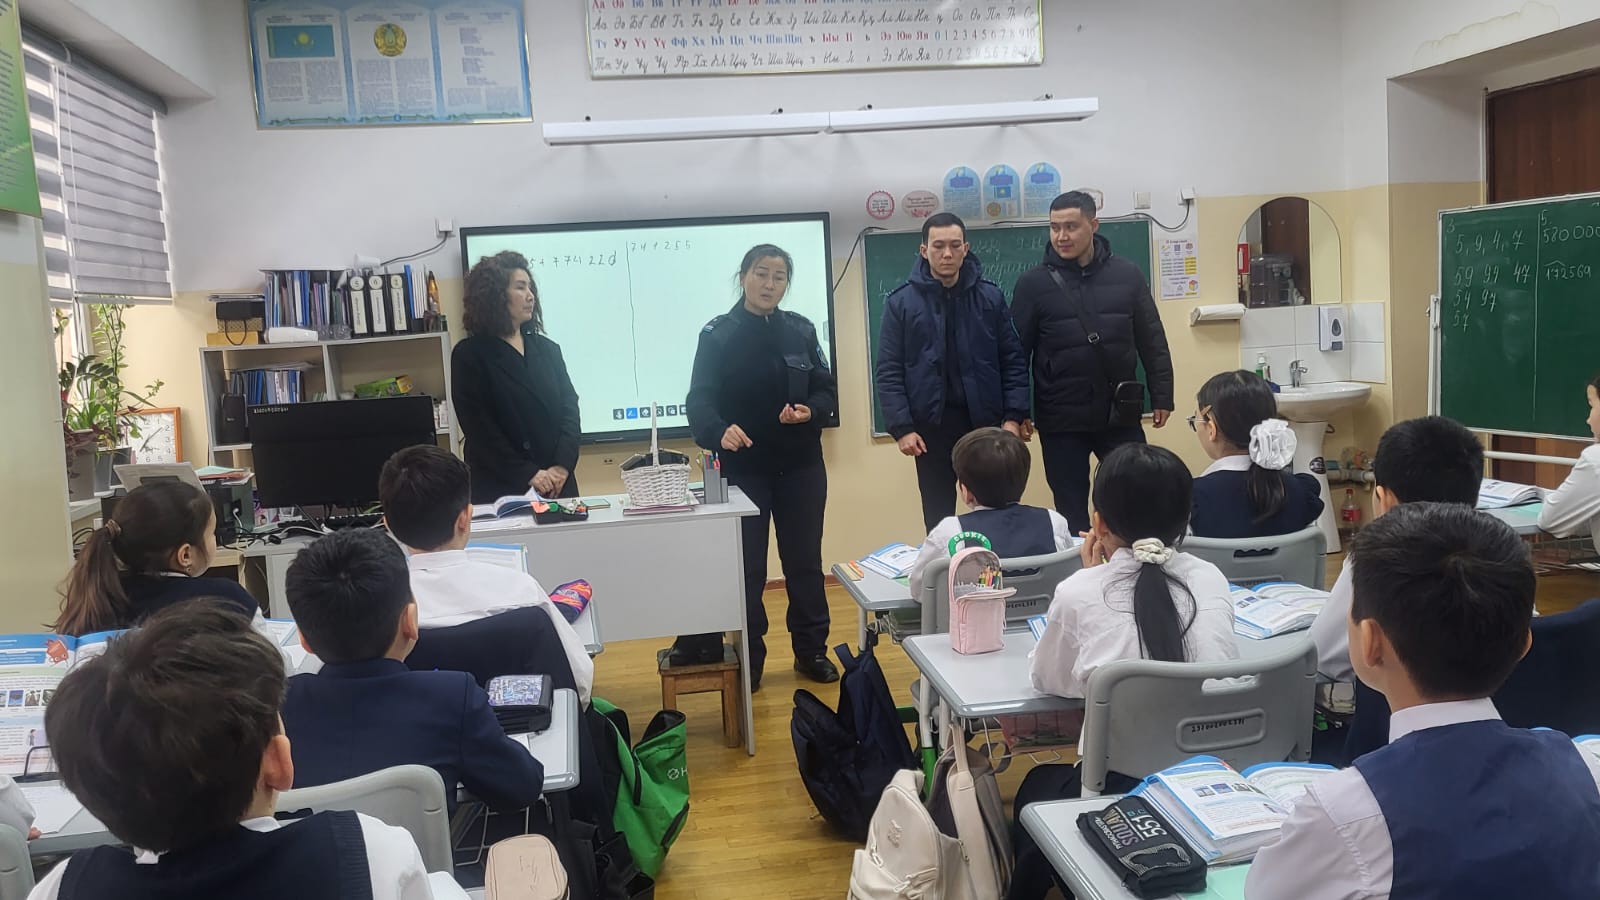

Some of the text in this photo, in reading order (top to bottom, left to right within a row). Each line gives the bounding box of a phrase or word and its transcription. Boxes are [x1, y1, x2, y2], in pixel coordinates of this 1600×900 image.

[953, 30, 958, 40] 2
[1454, 266, 1474, 287] 59
[1130, 814, 1168, 838] 551
